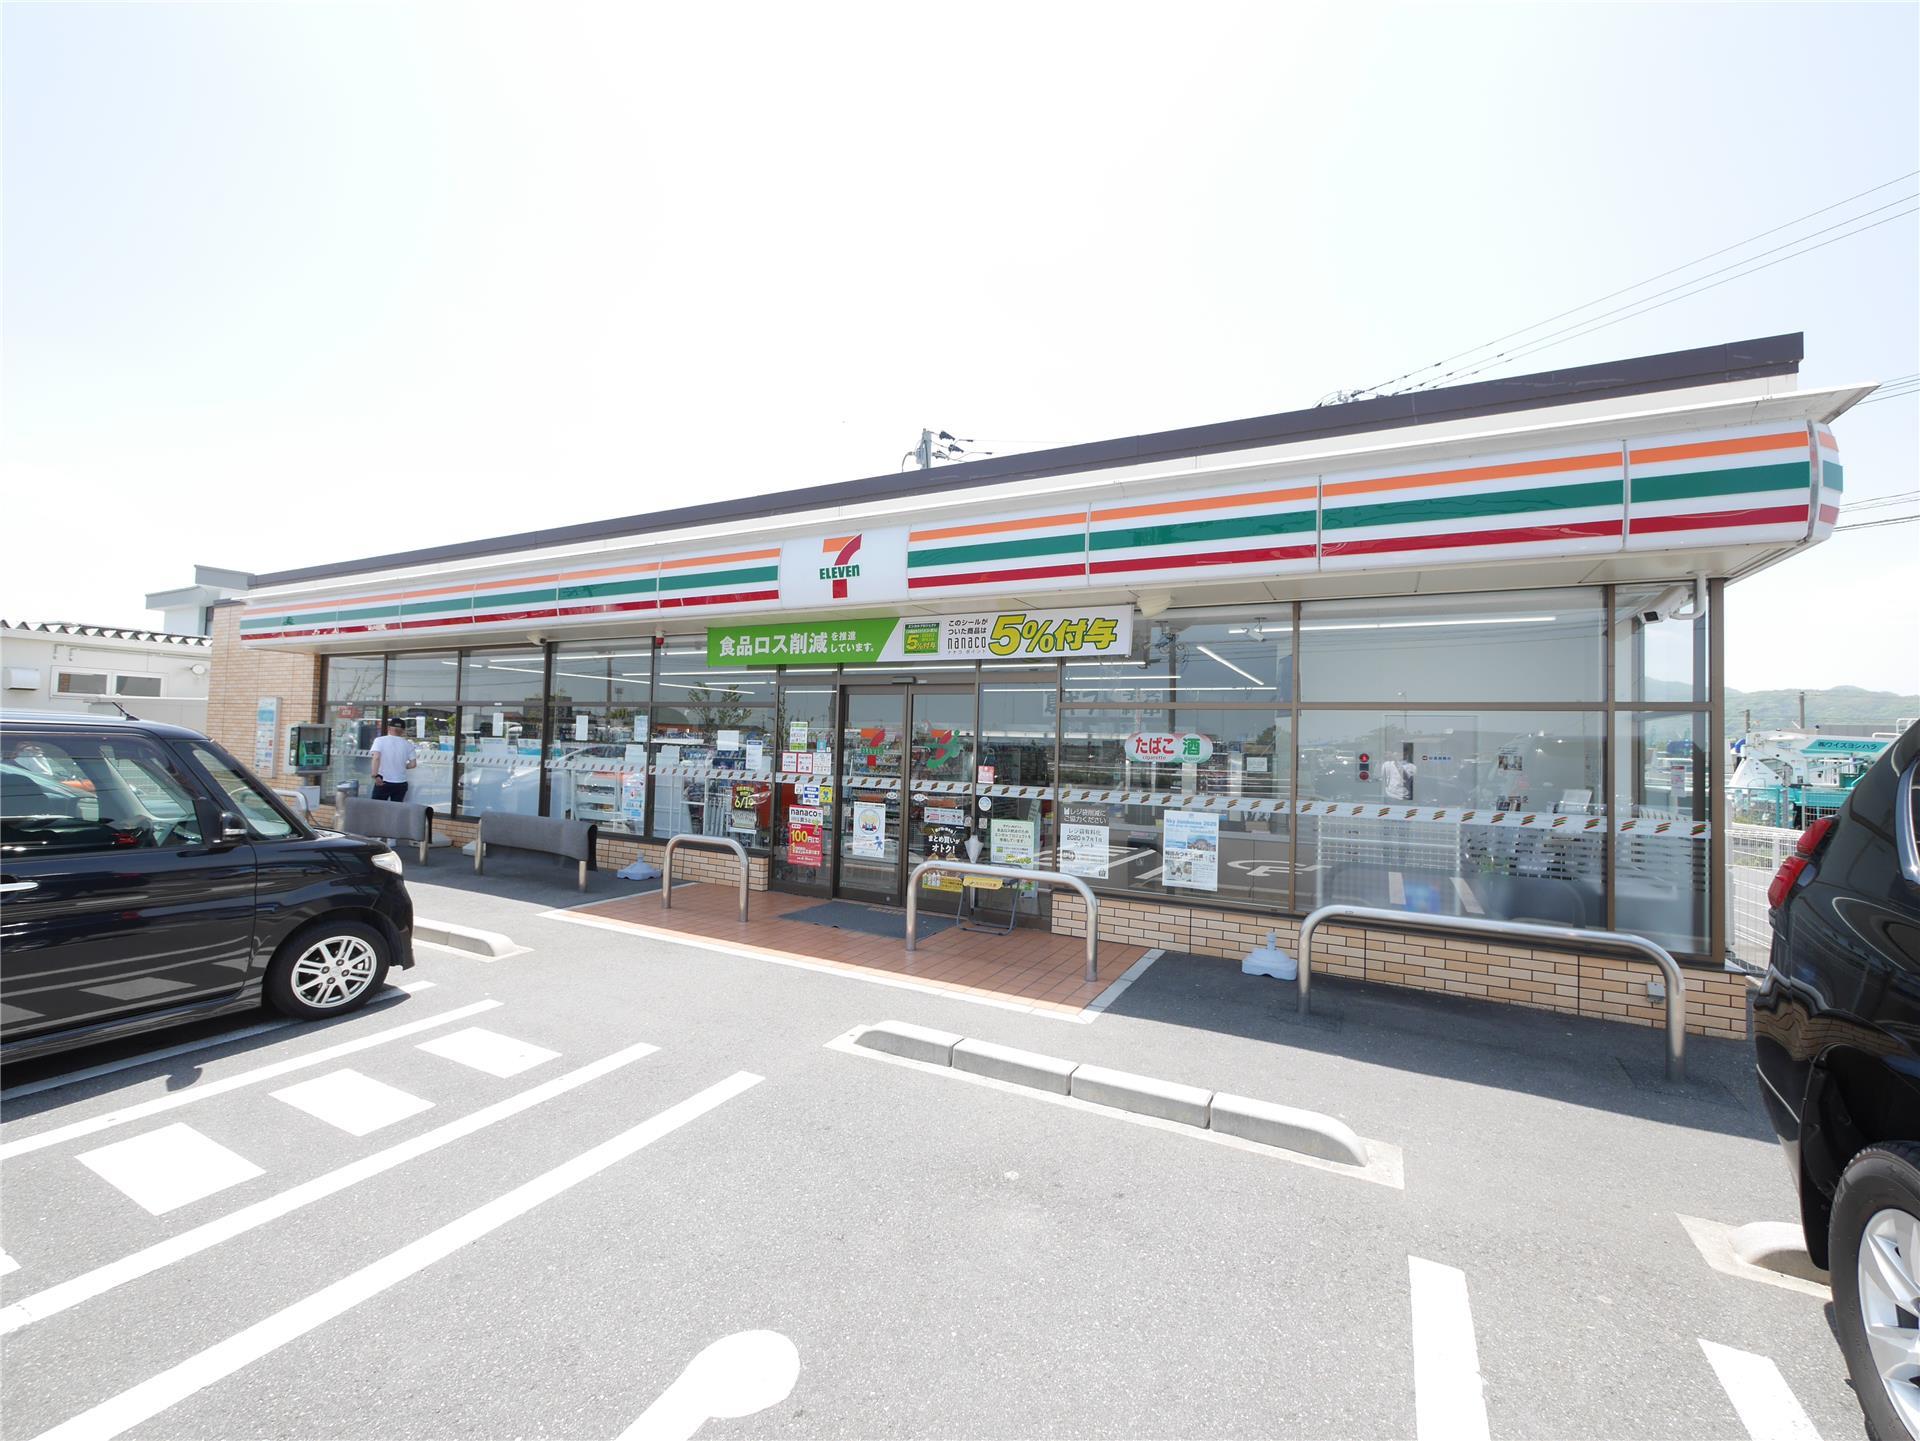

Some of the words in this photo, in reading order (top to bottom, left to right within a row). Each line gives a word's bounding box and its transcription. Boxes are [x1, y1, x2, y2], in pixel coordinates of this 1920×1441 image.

[949, 618, 988, 627] このシールが
[831, 631, 857, 641] を推進
[948, 627, 987, 636] ついた商品は
[988, 614, 1118, 656] 5%付与
[719, 631, 829, 658] 食品ロス削減
[830, 642, 875, 654] しています。
[947, 636, 987, 650] nanaco
[1135, 737, 1174, 755] たばこ
[1183, 738, 1200, 755] 酒
[1063, 815, 1107, 824] ご協力ください
[928, 835, 960, 845] まとめ買いが
